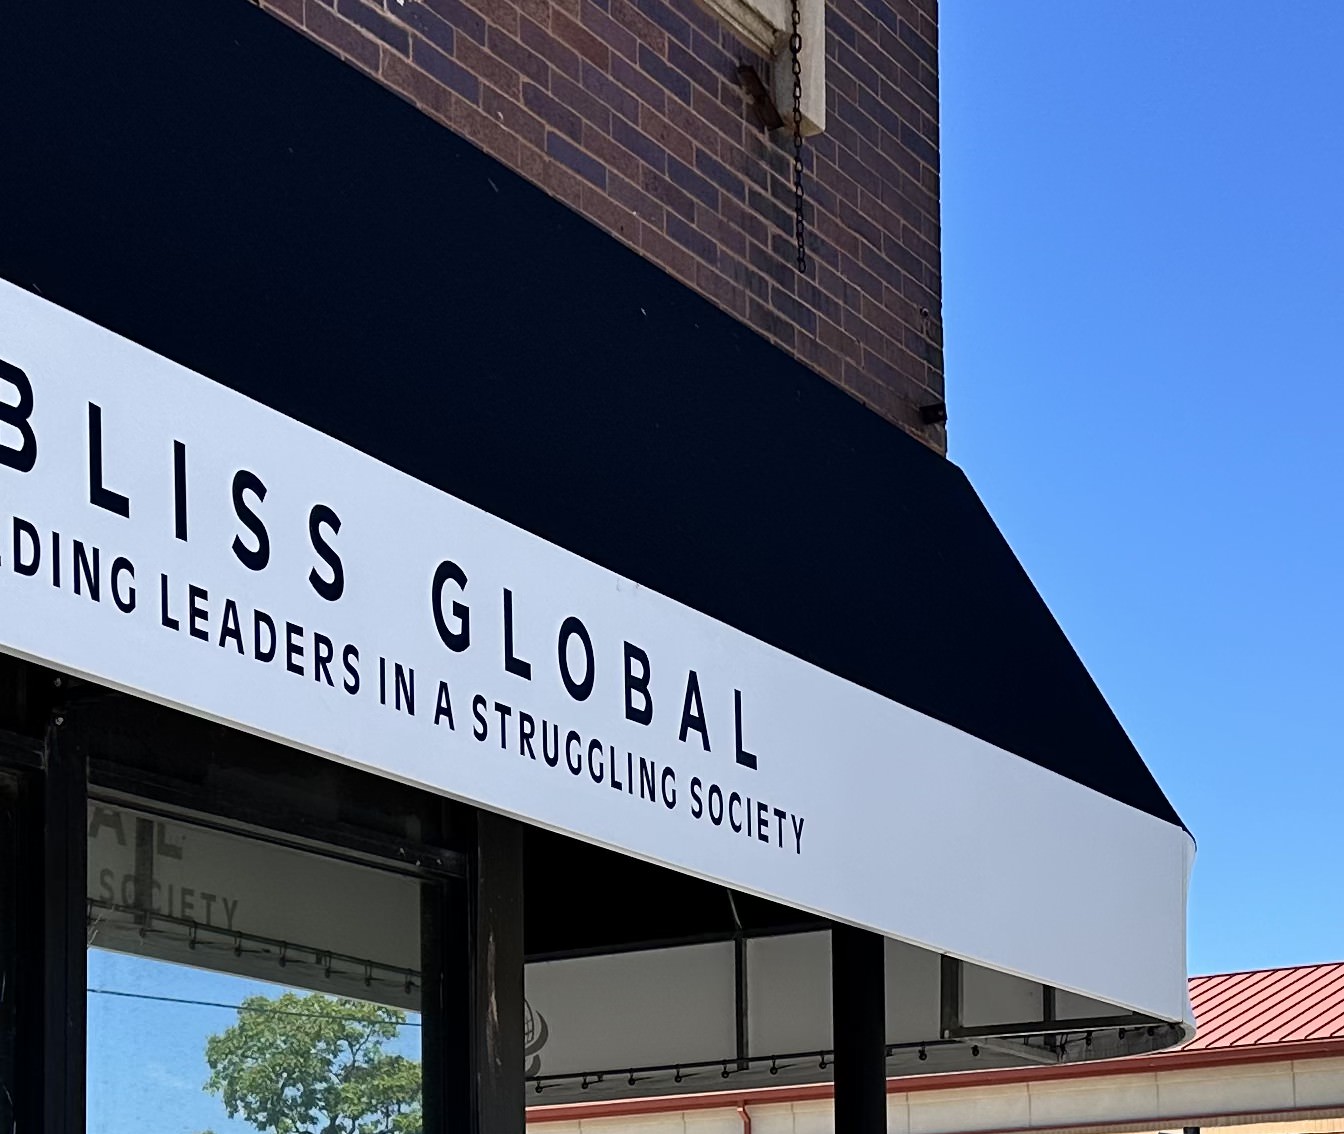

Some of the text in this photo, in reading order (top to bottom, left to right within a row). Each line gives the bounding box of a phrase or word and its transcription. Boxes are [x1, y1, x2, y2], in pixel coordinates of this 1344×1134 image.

[160, 573, 361, 697] LEADERS
[379, 656, 416, 717] IN
[433, 680, 456, 732] A
[472, 694, 678, 811] STRUGGLING
[690, 776, 806, 856] SOCIETY
[431, 560, 759, 771] GLOBAL
